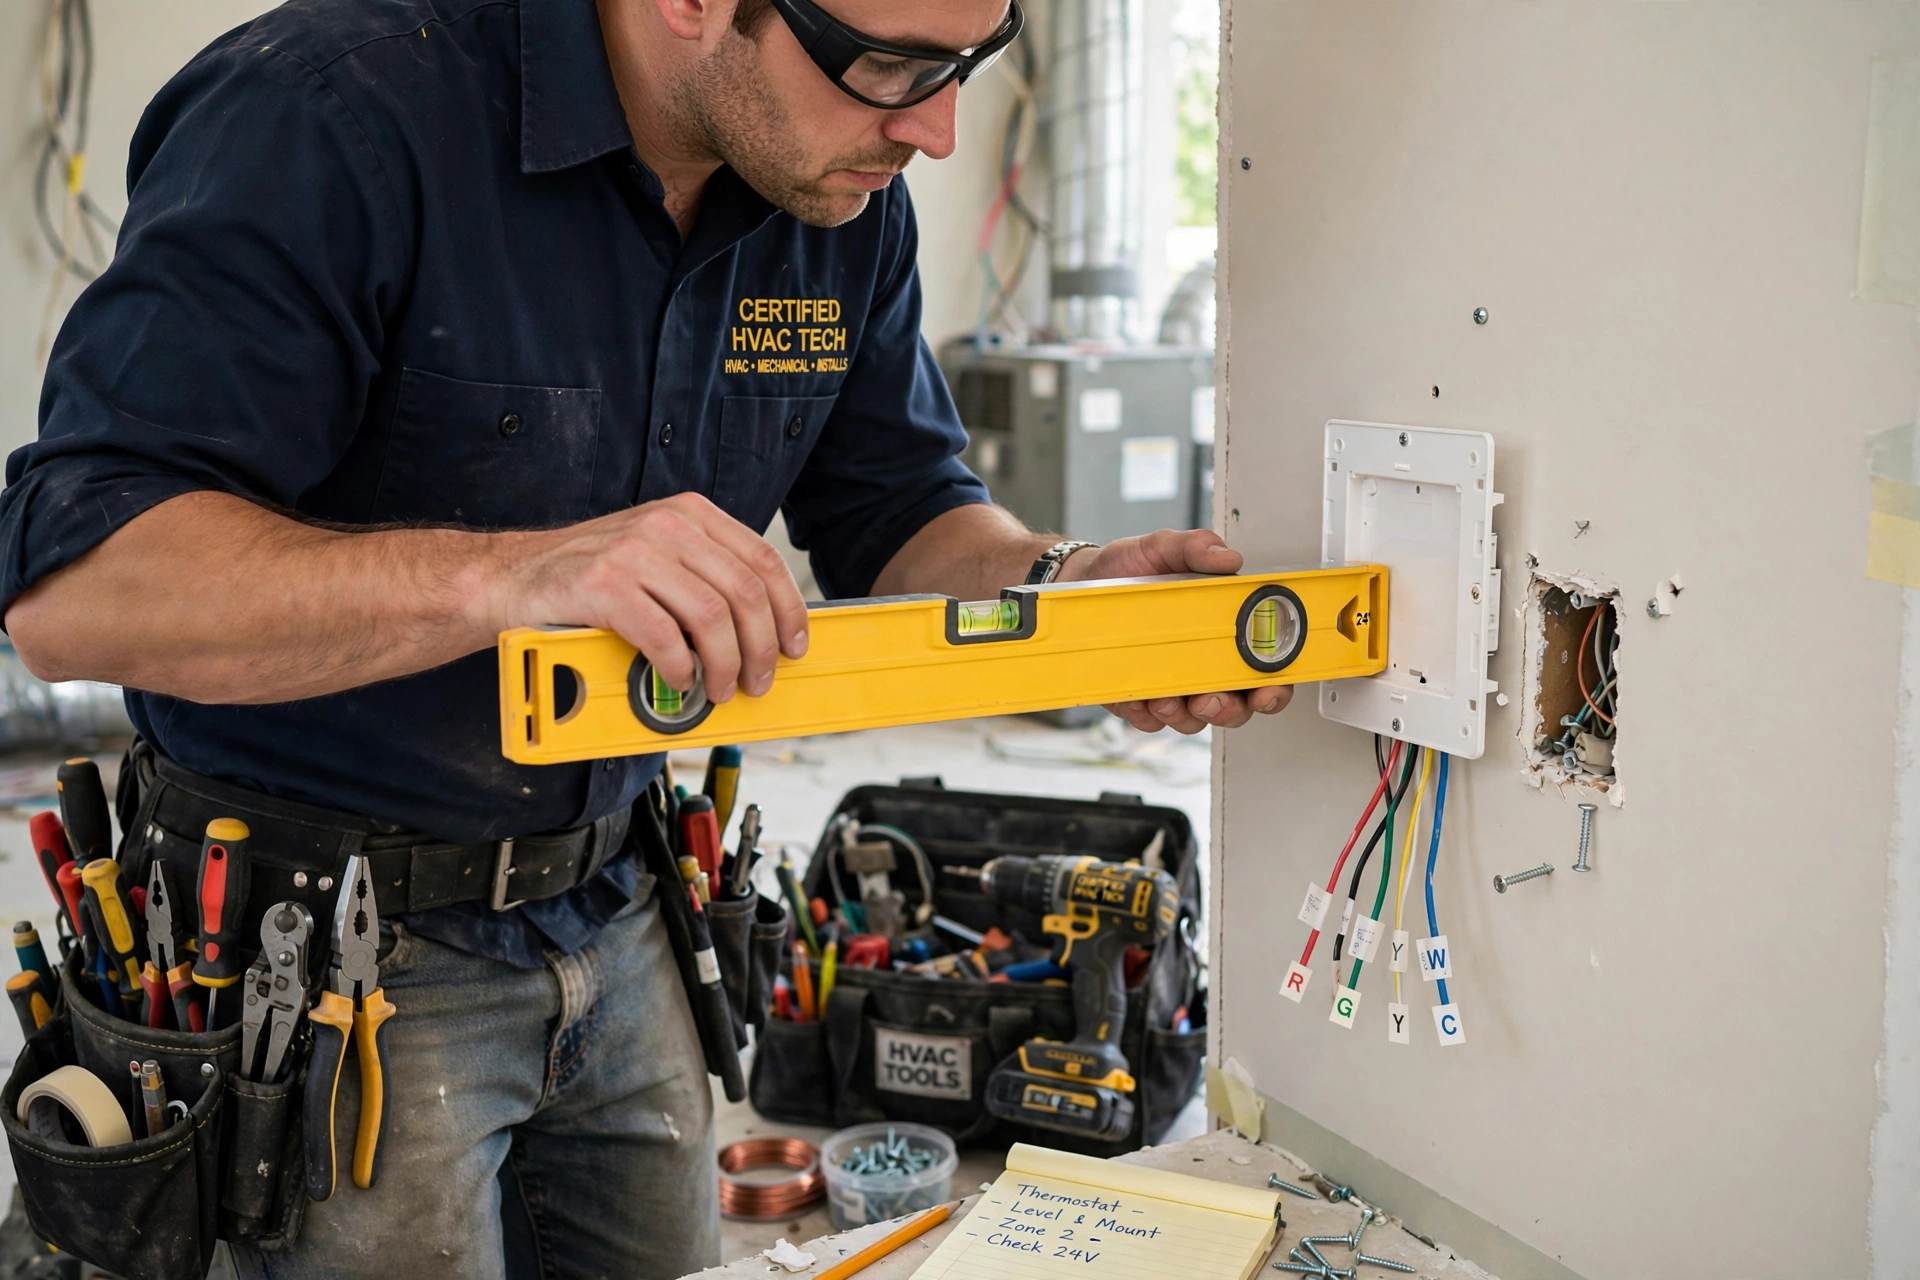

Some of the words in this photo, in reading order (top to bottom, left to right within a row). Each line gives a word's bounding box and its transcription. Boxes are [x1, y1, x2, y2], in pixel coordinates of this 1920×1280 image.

[739, 298, 841, 323] CERTIFIED
[732, 327, 792, 352] HVAC
[797, 327, 847, 352] TECH
[725, 359, 749, 374] HVAC
[757, 358, 810, 374] MECHANICAL
[816, 357, 849, 373] INSTALLS
[1392, 942, 1404, 961] Y
[1426, 948, 1446, 970] W
[1287, 971, 1304, 993] R
[1337, 997, 1354, 1019] G
[1393, 1013, 1405, 1034] Y
[1441, 1014, 1457, 1035] C
[889, 1041, 957, 1067] HVAC
[884, 1063, 961, 1089] TOOLS
[1017, 1183, 1122, 1213] Thermostat
[998, 1217, 1046, 1236] Zone
[1058, 1229, 1074, 1241] 2
[1010, 1200, 1064, 1221] Level
[1073, 1214, 1086, 1225] &
[1095, 1217, 1162, 1239] Mount
[987, 1233, 1044, 1254] Check
[1053, 1246, 1100, 1263] 24V
